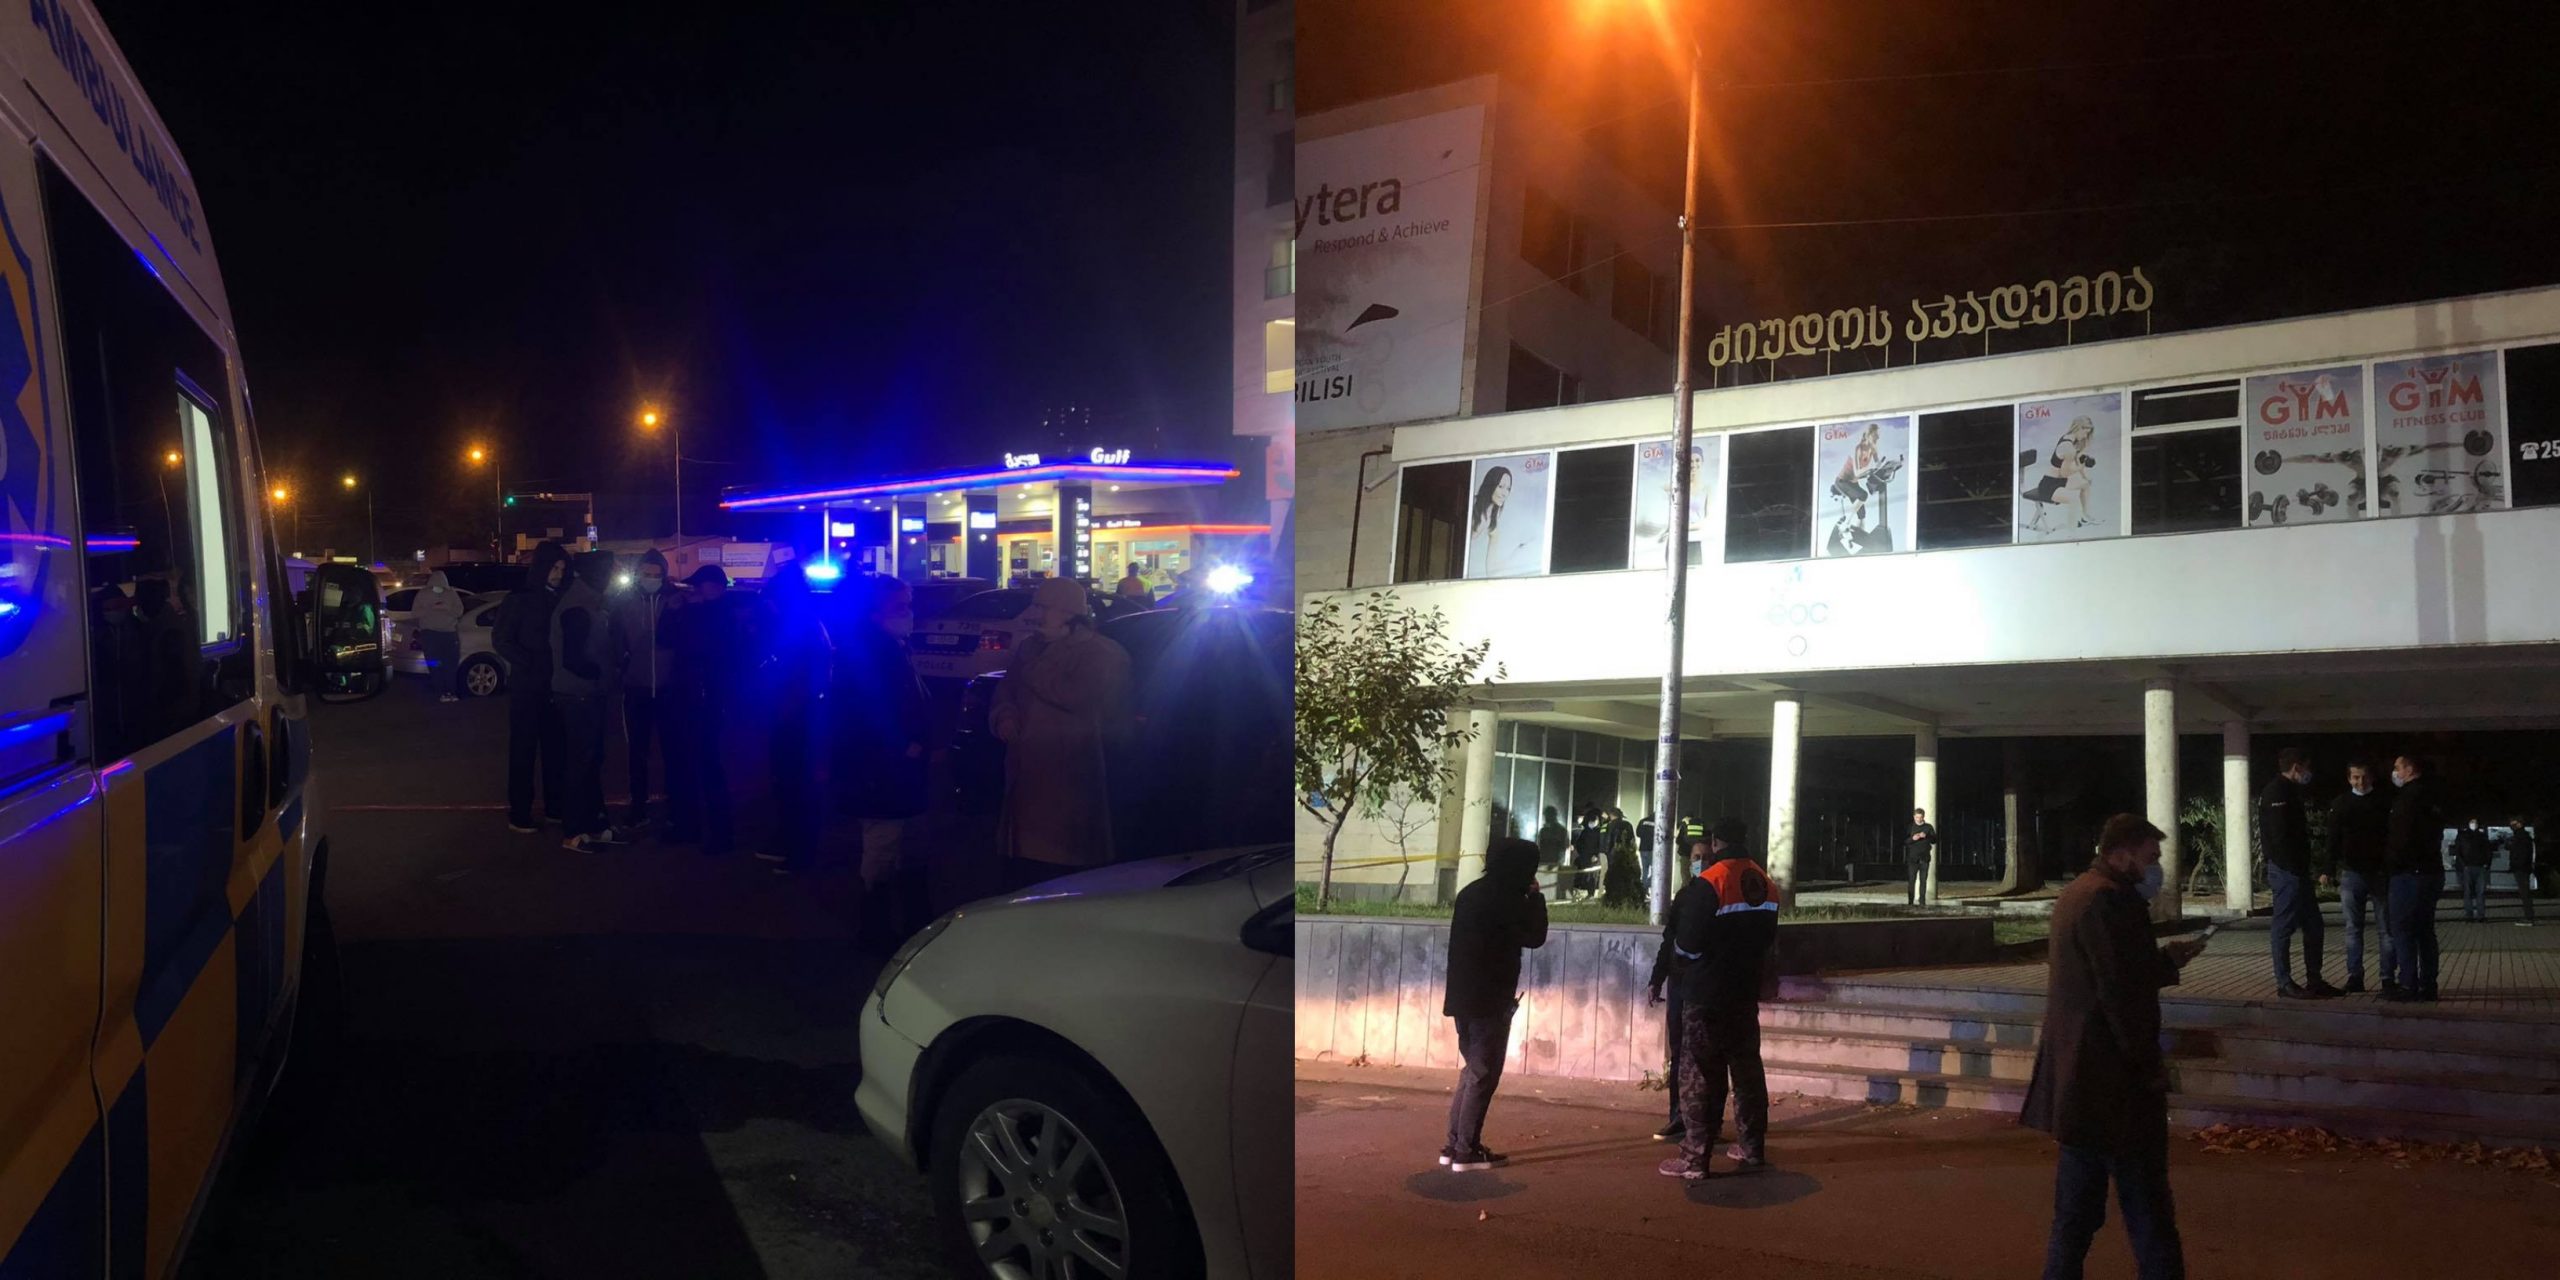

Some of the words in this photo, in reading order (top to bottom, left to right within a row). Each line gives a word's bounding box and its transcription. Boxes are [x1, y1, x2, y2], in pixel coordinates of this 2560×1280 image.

[1295, 178, 1401, 240] ytera
[1314, 229, 1375, 255] Respond
[1379, 226, 1389, 243] &
[1392, 218, 1450, 240] Achieve
[1906, 266, 2154, 342] აკადემია
[2260, 383, 2350, 425] GYM
[2389, 367, 2485, 412] GYM
[2393, 413, 2446, 428] FITNESS
[2449, 409, 2486, 423] CLUB
[1091, 447, 1131, 465] Gulf
